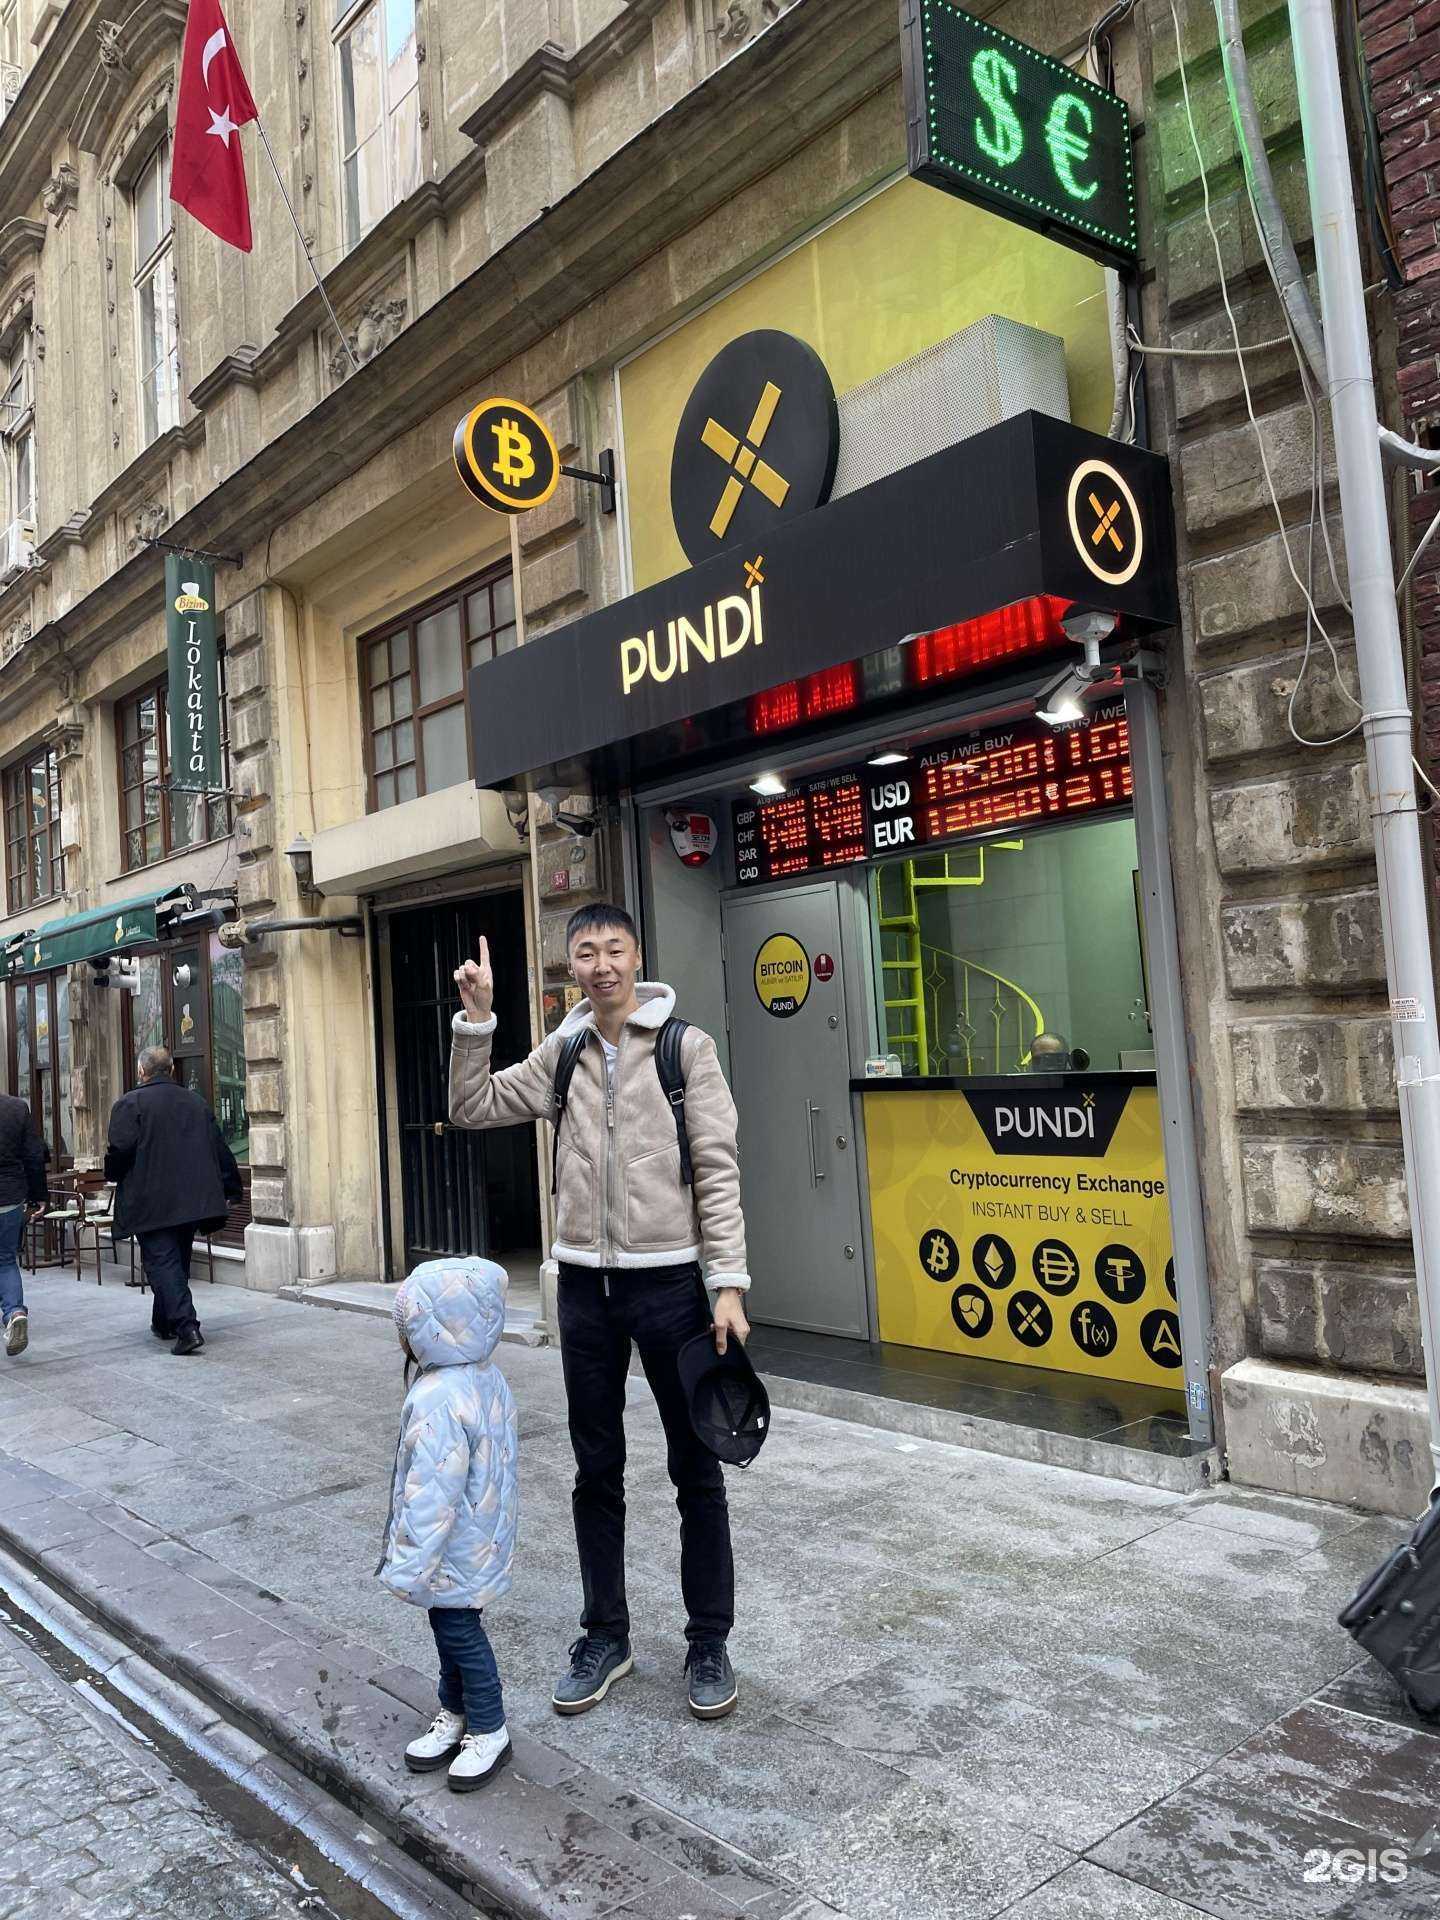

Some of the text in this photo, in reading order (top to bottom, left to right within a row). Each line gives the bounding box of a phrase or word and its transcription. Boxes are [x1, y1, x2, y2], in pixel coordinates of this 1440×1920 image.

[179, 597, 206, 609] Bizim
[185, 620, 206, 773] Lokanta
[958, 742, 981, 758] WE
[984, 733, 1015, 752] BUY
[870, 780, 911, 812] USD
[736, 811, 756, 826] GBP
[737, 830, 756, 844] CHF
[873, 816, 915, 848] EUR
[738, 848, 758, 862] SAR
[739, 866, 759, 880] CAD
[760, 960, 803, 977] BITCOIN
[949, 1168, 1166, 1199] Cryptocurrency Exchange
[972, 1201, 1133, 1227] INSTANT BUY & SELL
